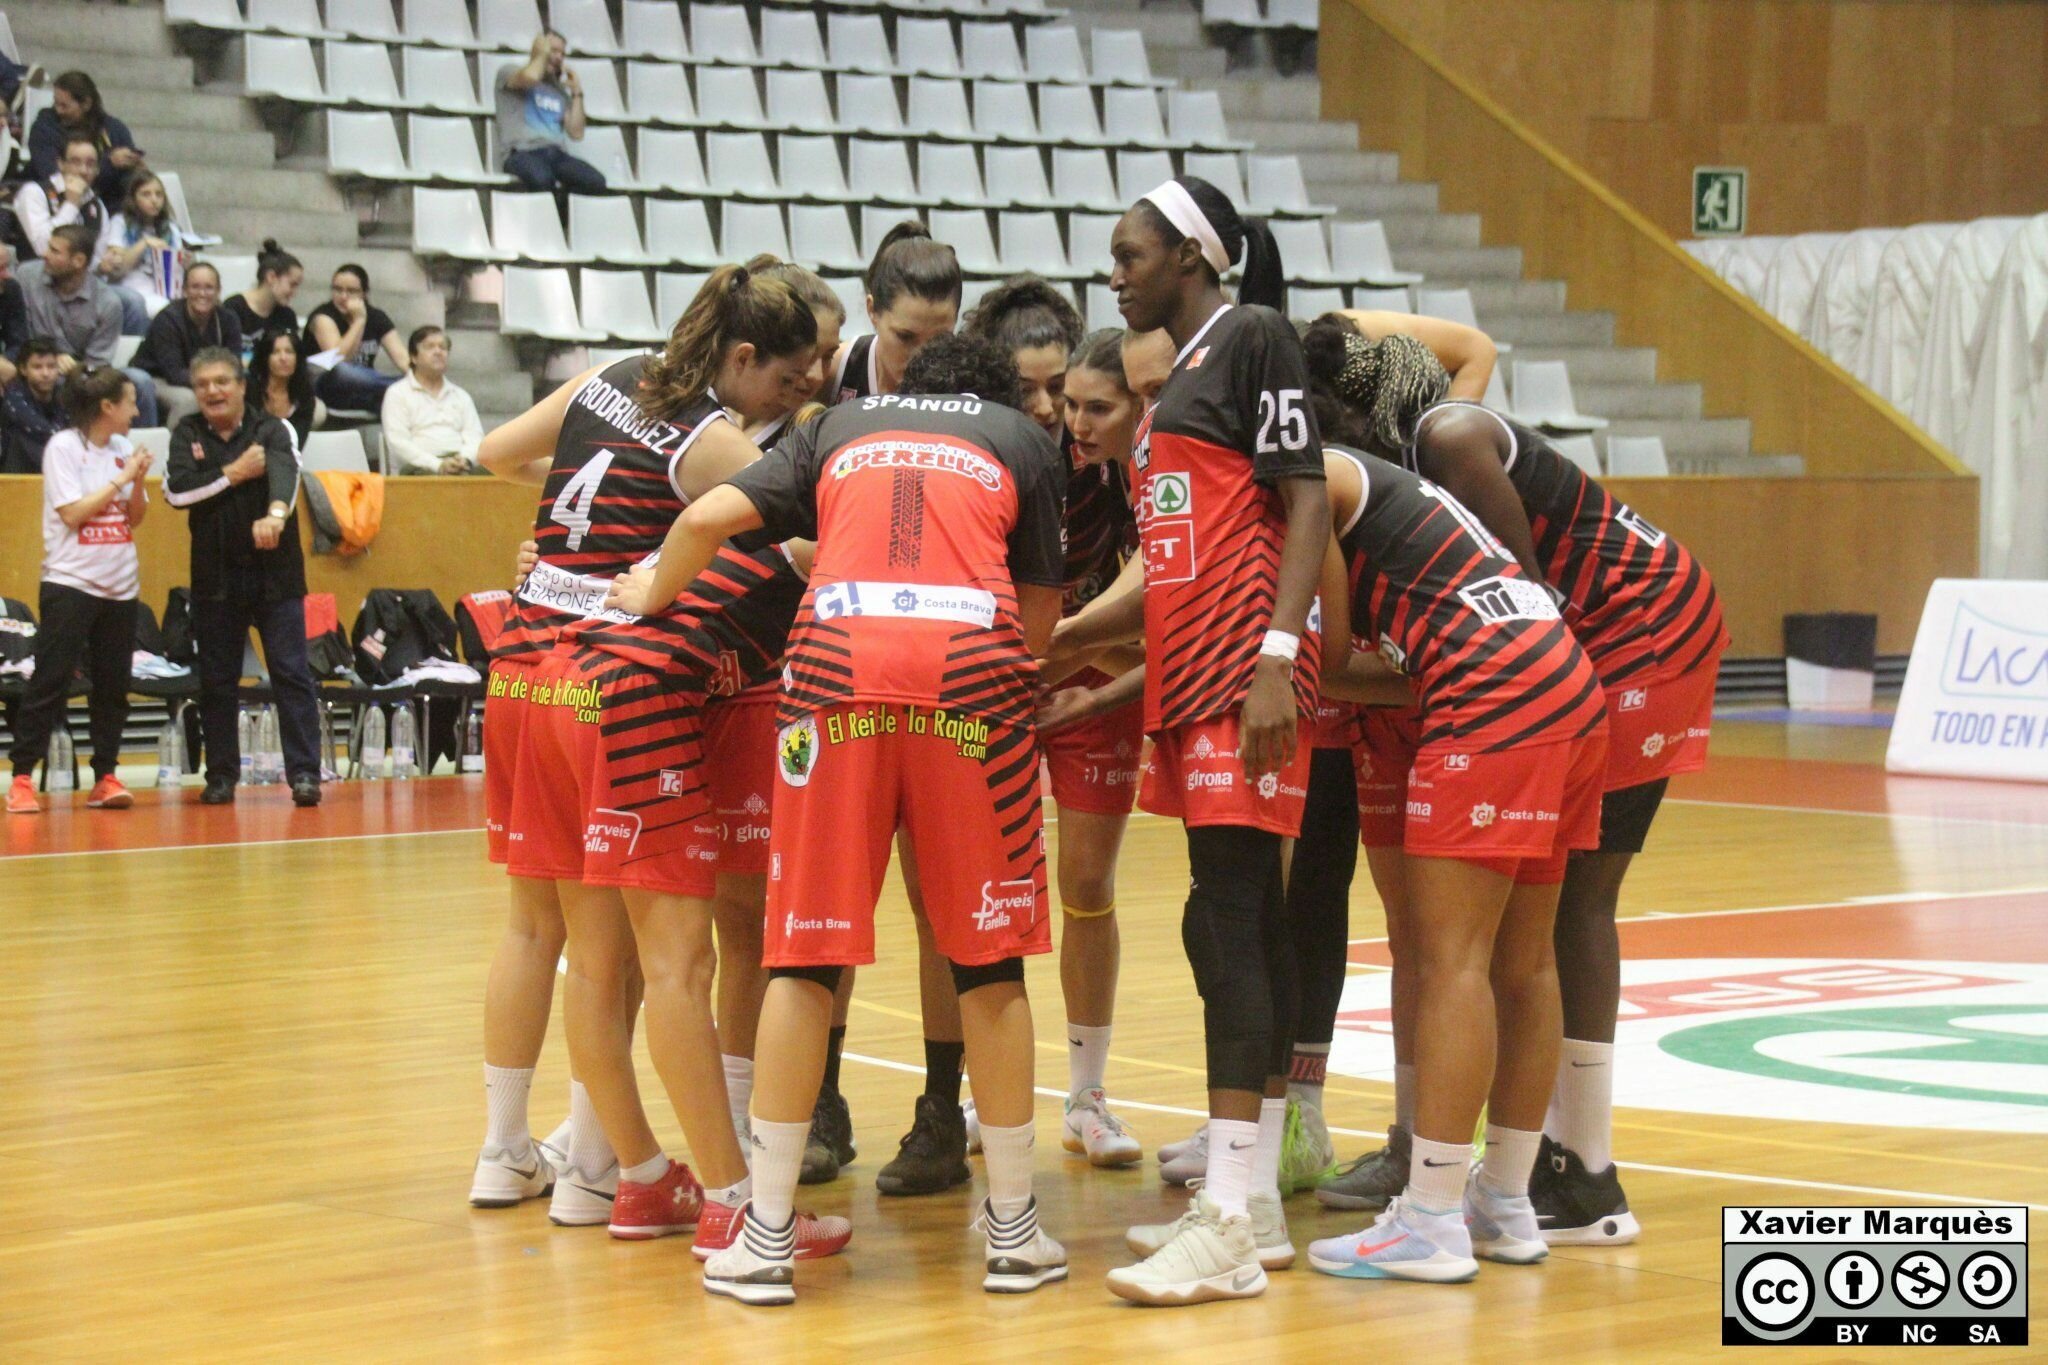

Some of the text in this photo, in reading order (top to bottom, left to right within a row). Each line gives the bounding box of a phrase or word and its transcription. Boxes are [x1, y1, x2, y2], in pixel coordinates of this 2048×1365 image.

[862, 394, 982, 415] SPANOU
[578, 376, 681, 455] RODRIGUEZ
[1256, 389, 1309, 454] 25
[549, 448, 615, 552] 4
[924, 598, 957, 609] Costa
[960, 600, 992, 616] Brava
[826, 713, 845, 744] El
[847, 710, 876, 740] Rei
[907, 704, 927, 735] la
[933, 708, 989, 746] Rajola
[1931, 711, 1996, 745] TODO
[1998, 713, 2036, 748] EN
[957, 742, 986, 760] .com
[1187, 769, 1233, 791] girona
[1501, 809, 1533, 820] Costa
[587, 823, 631, 839] erveis
[736, 824, 771, 843] giro
[793, 918, 851, 929] Costa Brava
